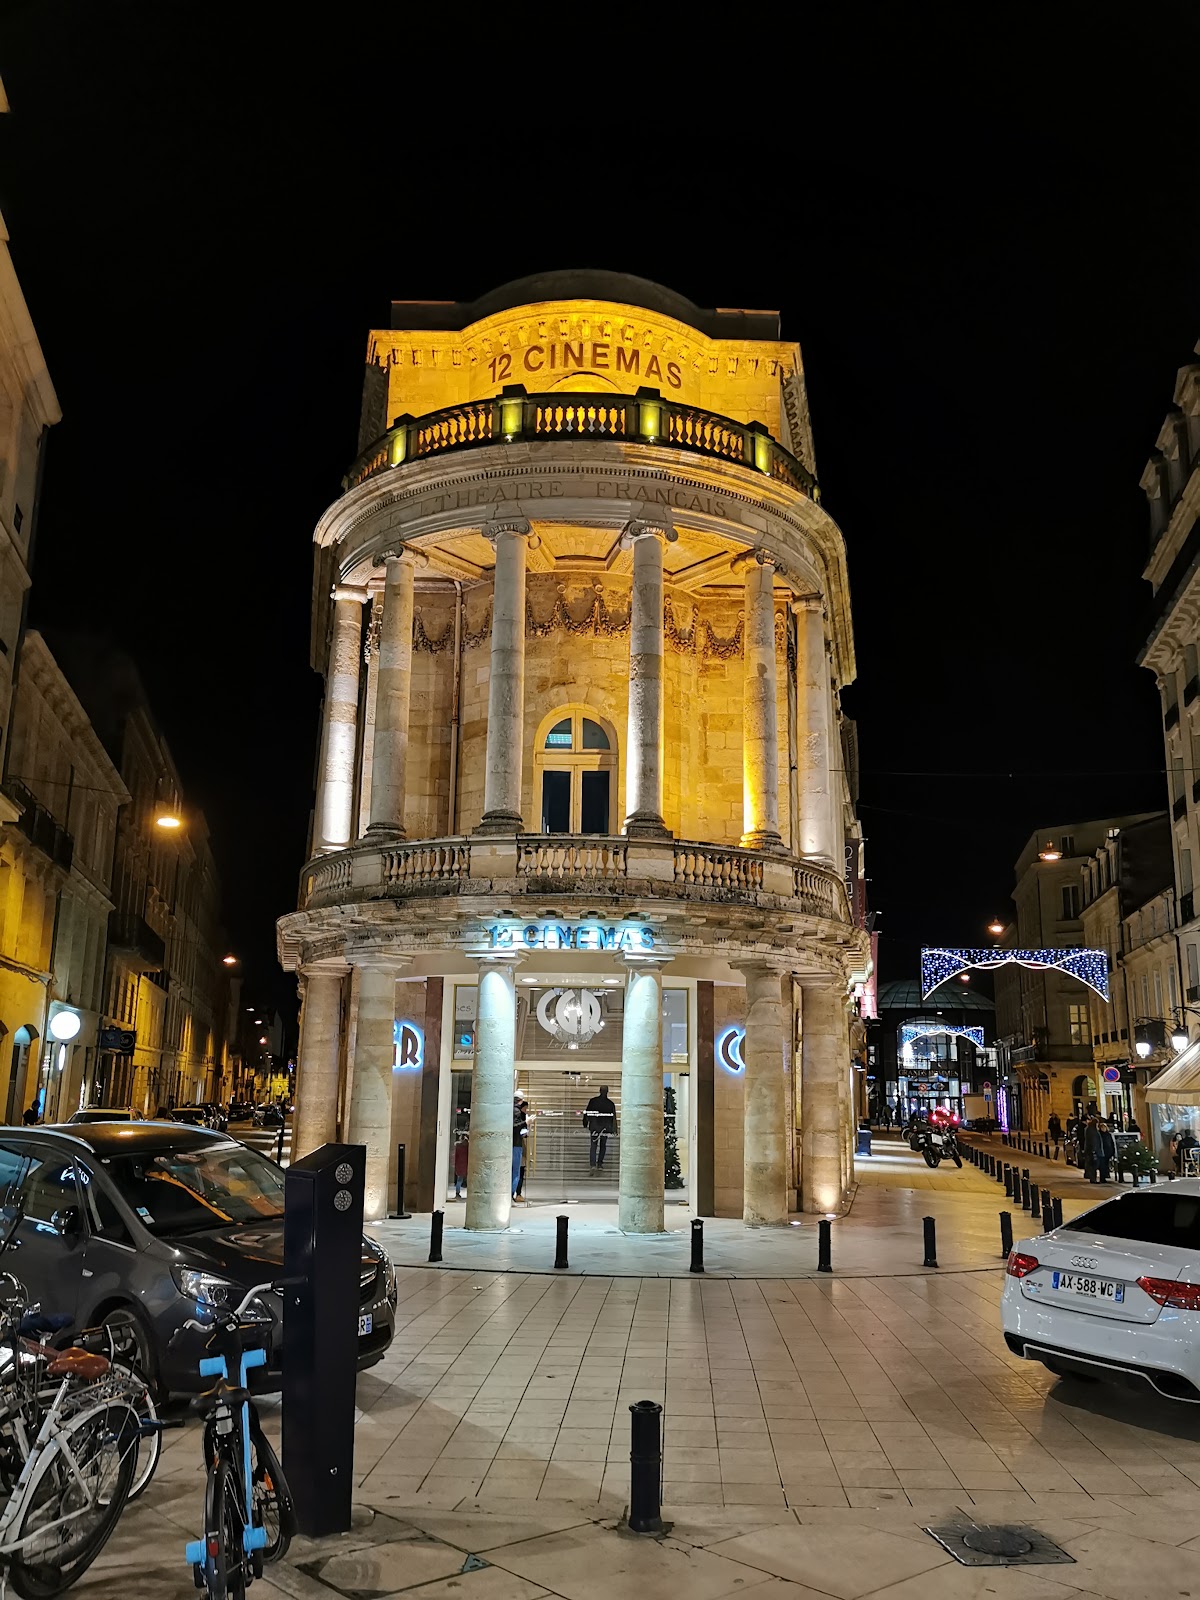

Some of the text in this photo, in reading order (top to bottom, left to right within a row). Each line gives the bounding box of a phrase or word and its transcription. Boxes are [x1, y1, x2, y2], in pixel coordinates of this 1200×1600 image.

[488, 341, 682, 390] 12 CINEMAS
[489, 925, 656, 950] 12 CINEMAS
[536, 988, 603, 1035] CGR
[392, 1024, 420, 1067] R
[721, 1029, 747, 1071] C
[1060, 1274, 1114, 1297] AX-588-WC
